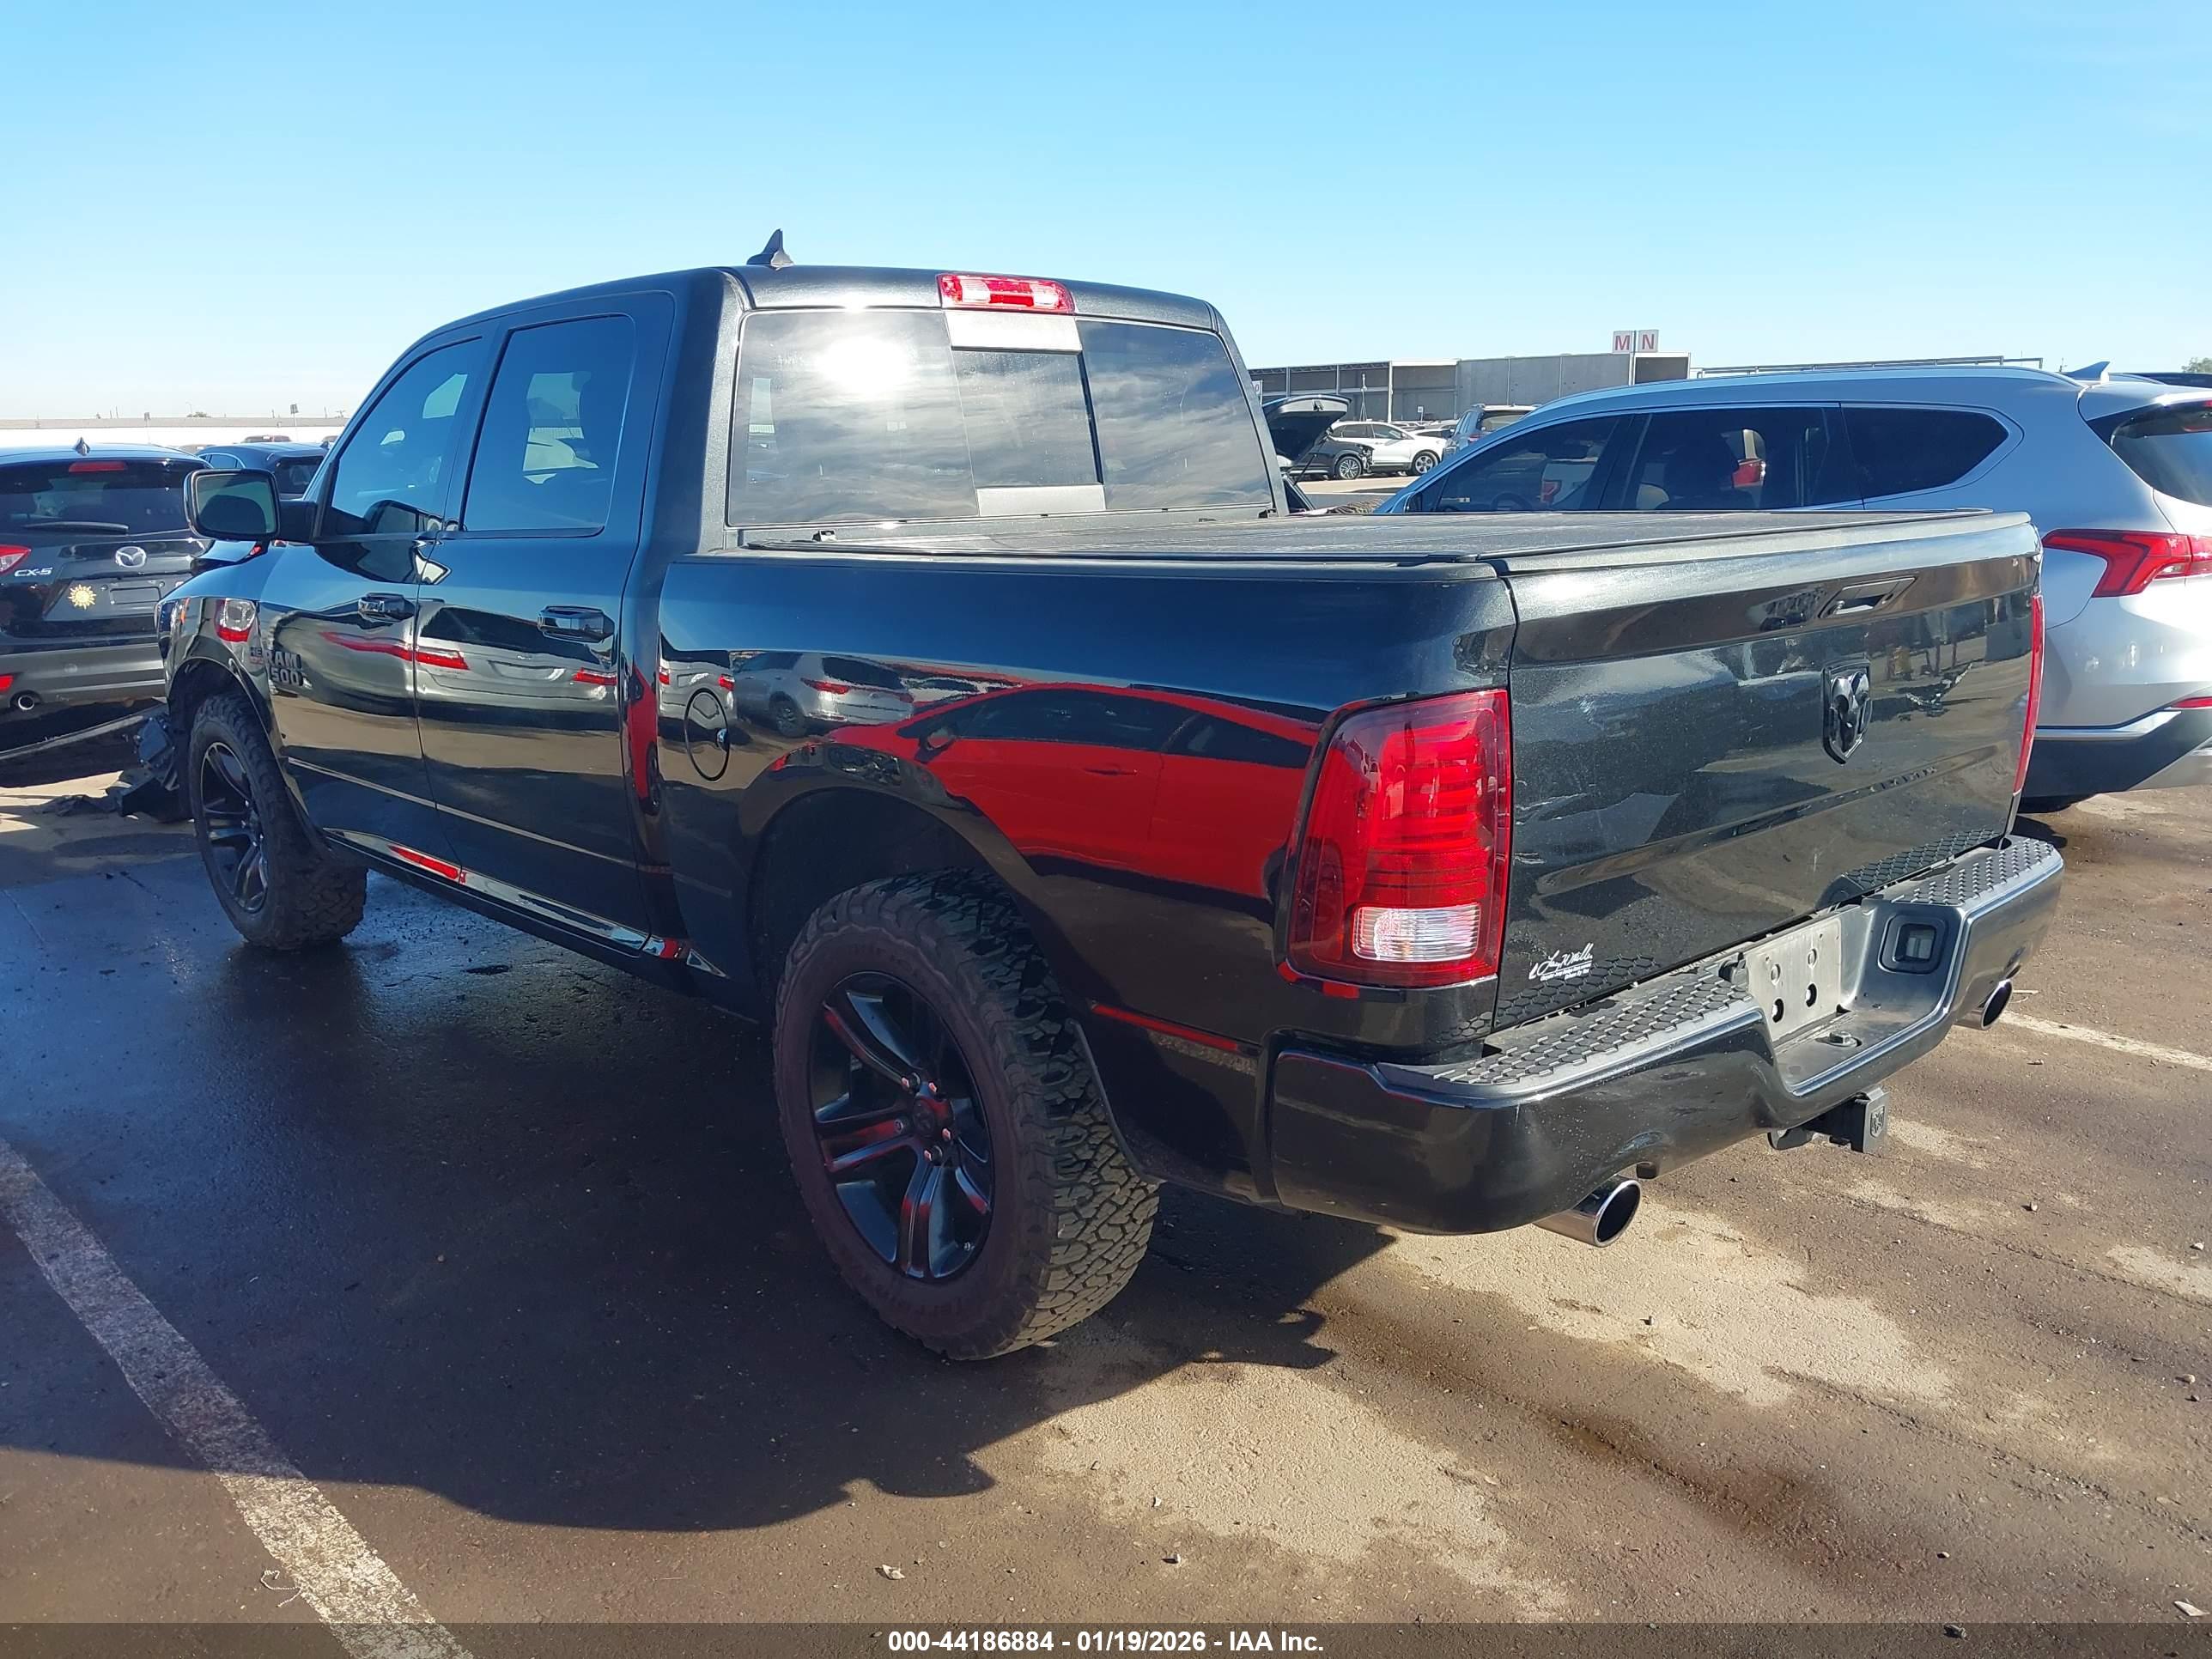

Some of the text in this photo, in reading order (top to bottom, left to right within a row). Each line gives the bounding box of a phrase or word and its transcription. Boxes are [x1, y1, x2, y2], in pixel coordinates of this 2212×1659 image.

[1614, 335, 1630, 351] M
[1641, 333, 1655, 350] N
[14, 567, 53, 577] CX-5
[263, 649, 301, 668] RAM
